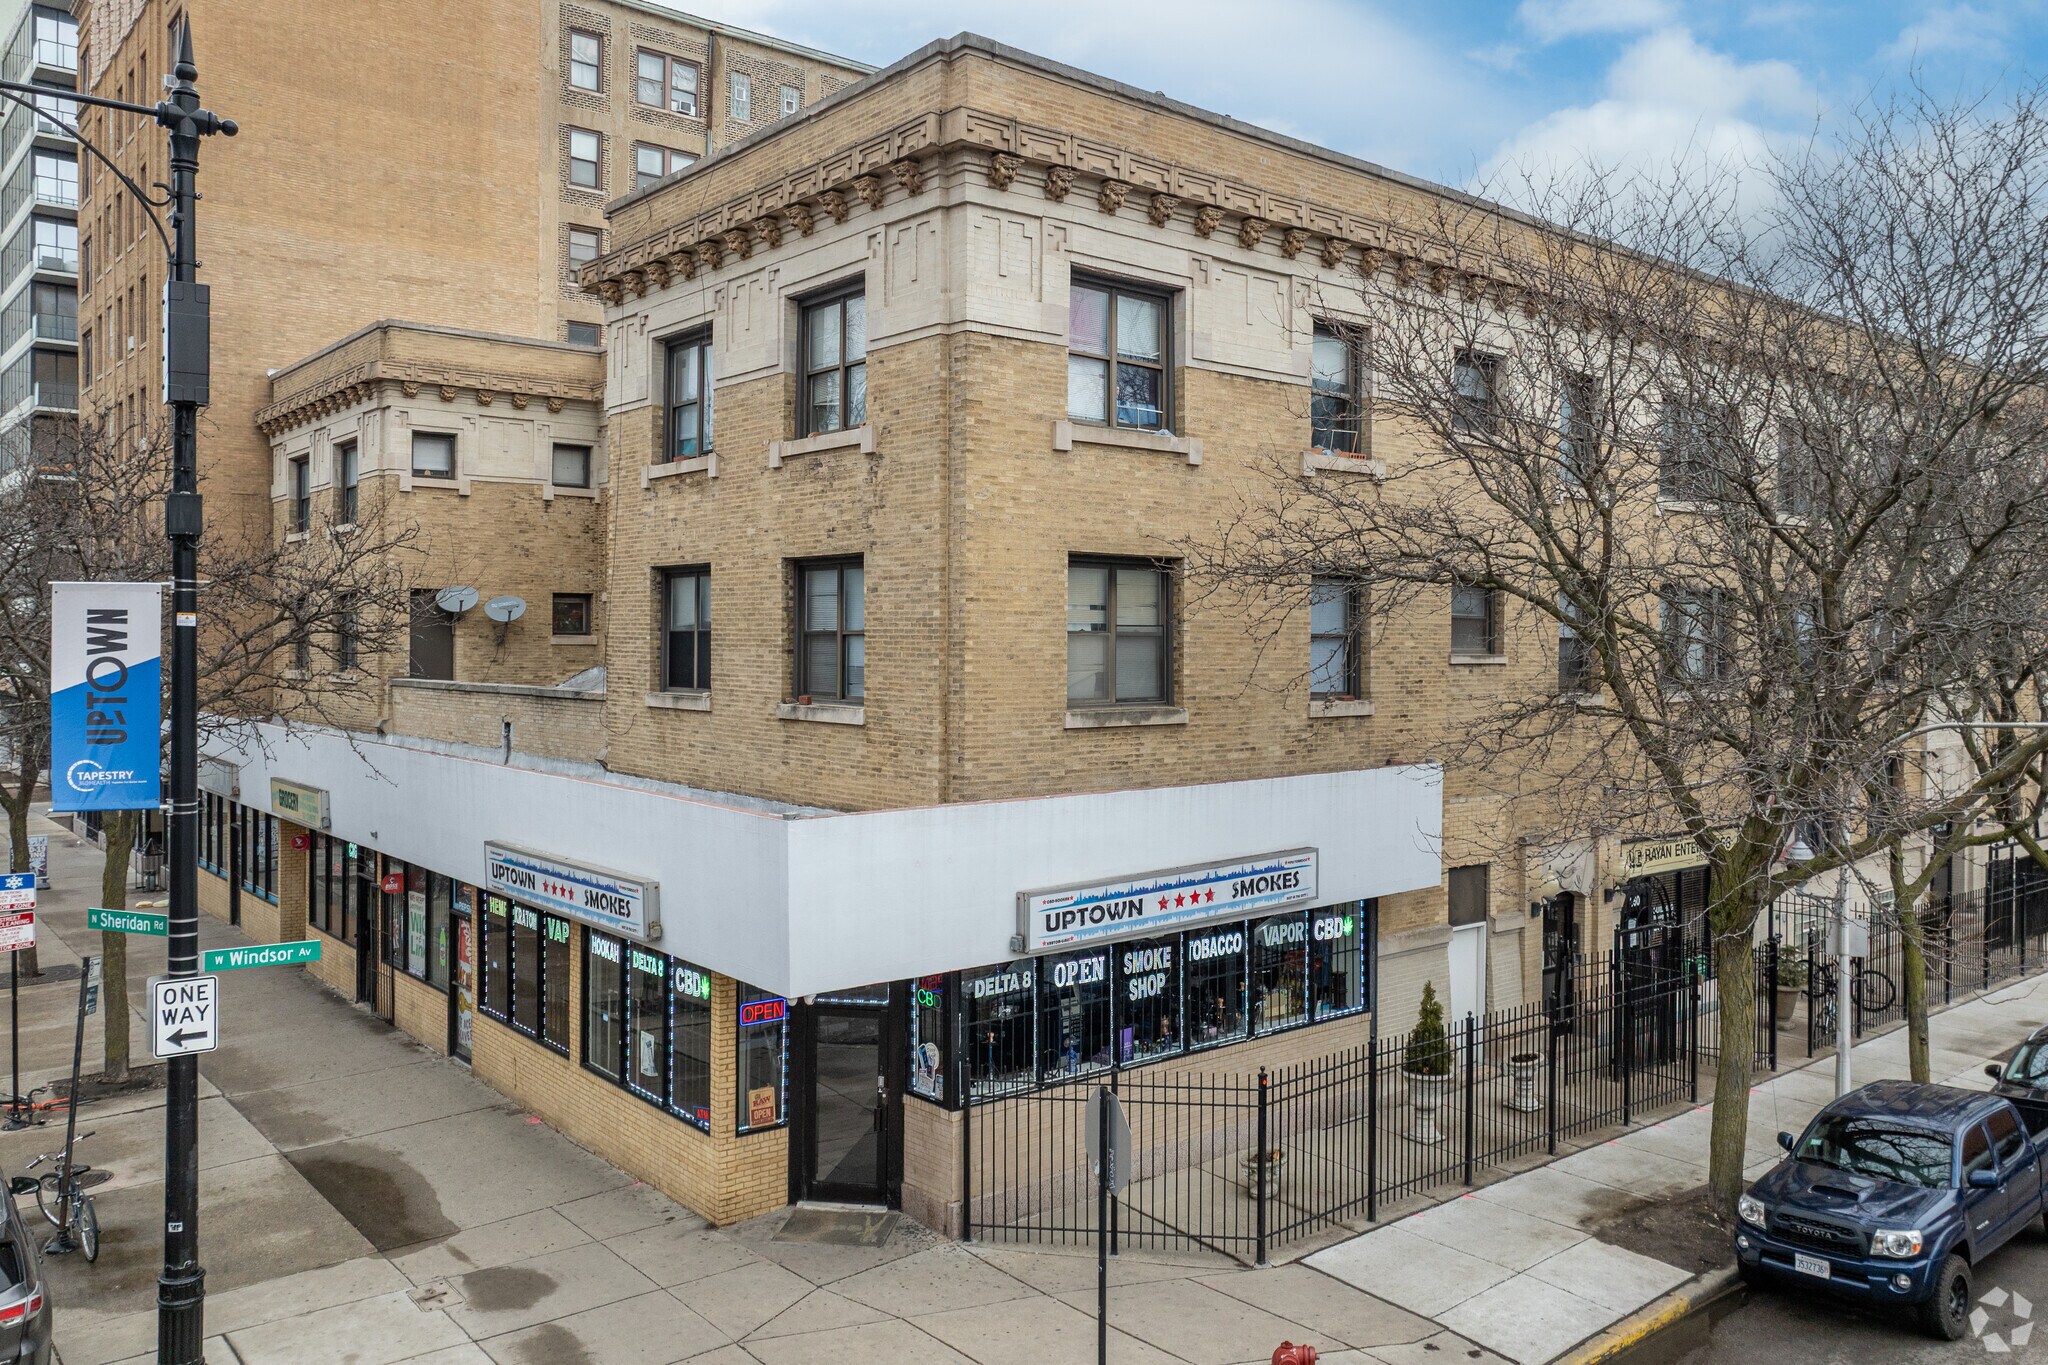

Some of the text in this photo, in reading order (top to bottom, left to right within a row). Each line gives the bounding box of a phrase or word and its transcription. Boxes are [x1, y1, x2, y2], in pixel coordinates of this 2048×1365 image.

[86, 609, 128, 745] UPTOWN
[77, 770, 134, 781] TAPESTRY
[278, 788, 299, 812] GROCERY
[1644, 845, 1672, 862] RAYAN
[491, 862, 631, 918] UPTOWN SMOKES
[1045, 870, 1300, 932] UPTOWN SMOKES
[92, 913, 163, 931] N Sheridan Rd
[547, 917, 570, 944] VAP
[1263, 922, 1305, 947] VAPOR
[1314, 916, 1343, 941] CBD
[215, 947, 311, 966] W Windsor Av
[592, 935, 620, 963] HOOKAH
[1188, 932, 1243, 962] TOBACCO
[632, 950, 664, 977] DELTA 8
[1053, 956, 1105, 987] OPEN
[1123, 946, 1172, 975] SMOKE
[163, 984, 209, 1005] ONE
[675, 967, 700, 998] CBD
[974, 971, 1032, 999] DELTA 8
[1128, 973, 1166, 1001] SHOP
[917, 988, 942, 1009] CBD
[162, 1004, 209, 1026] WAY
[742, 1001, 784, 1023] OPEN
[753, 1095, 771, 1107] RAW
[754, 1107, 771, 1120] OPEN
[1797, 1226, 1832, 1239] TOYOTA
